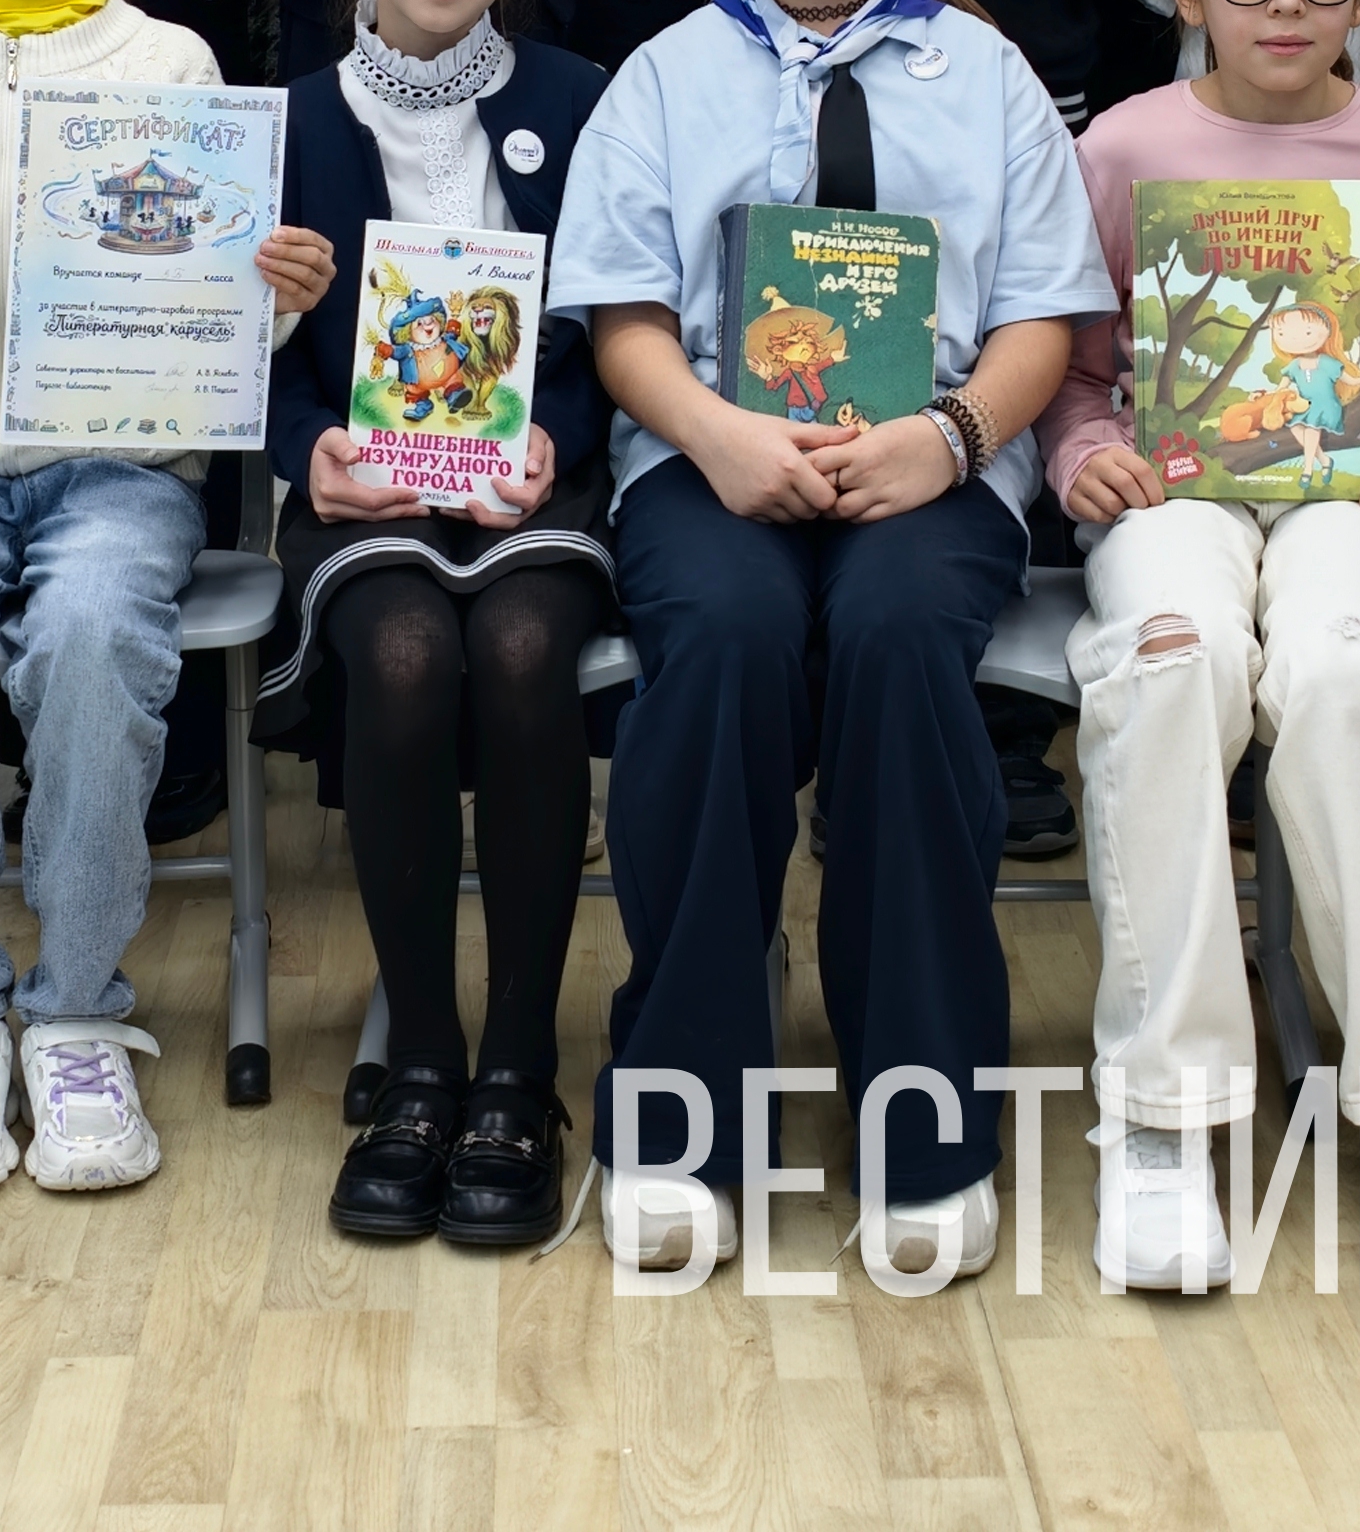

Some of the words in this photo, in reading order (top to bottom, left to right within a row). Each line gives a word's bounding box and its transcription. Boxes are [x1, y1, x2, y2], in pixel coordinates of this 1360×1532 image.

[65, 118, 239, 152] СЕРТИФИКАТ
[1192, 205, 1270, 232] ЛУЧШИЙ
[1274, 209, 1325, 232] ДРУГ
[791, 230, 930, 257] ПРИКЛЮЧЕНИЯ
[1237, 227, 1302, 245] ИМЕНИ
[794, 247, 900, 267] НЕЗНАЙКИ
[1200, 245, 1314, 275] ЛУЧИК
[53, 265, 102, 280] Вручается
[104, 271, 142, 282] команде
[204, 274, 234, 283] класса
[467, 263, 483, 277] А.
[488, 265, 534, 282] Волков
[819, 273, 898, 295] ДРУЗЕЙ
[846, 266, 860, 278] И
[863, 265, 898, 280] ЕГО
[38, 302, 49, 313] за
[51, 303, 88, 314] участие
[97, 304, 195, 316] литературно-игровой
[197, 308, 243, 318] программе
[48, 314, 165, 339] Литературная
[169, 322, 231, 342] карусель
[369, 428, 502, 457] ВОЛШЕБНИК
[358, 446, 512, 478] ИЗУМРУДНОГО
[391, 468, 474, 493] ГОРОДА
